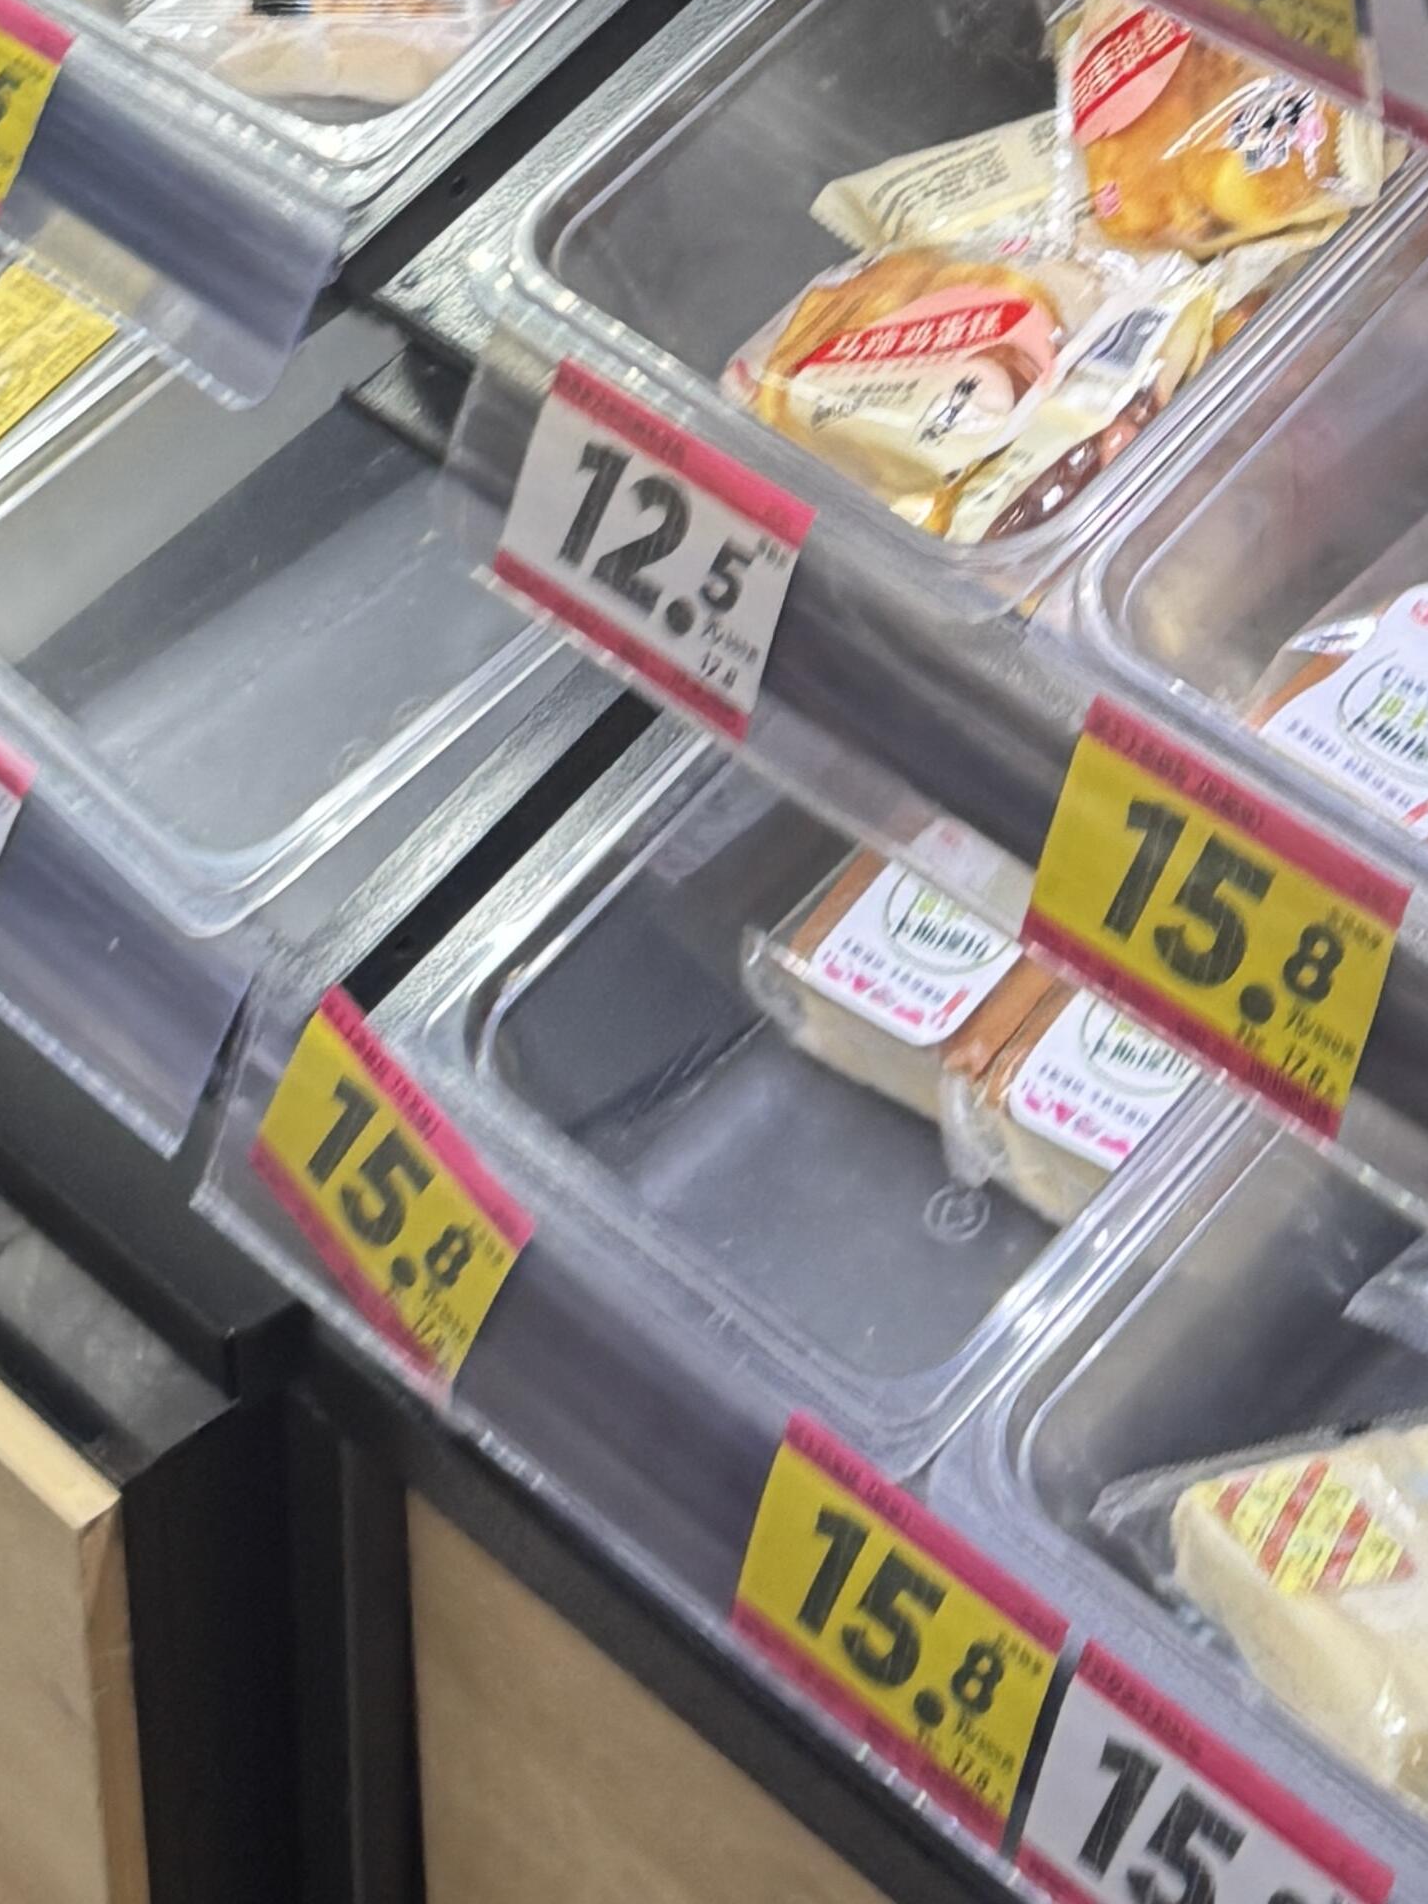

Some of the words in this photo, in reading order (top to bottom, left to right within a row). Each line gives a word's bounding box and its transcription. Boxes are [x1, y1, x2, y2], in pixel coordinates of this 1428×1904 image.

[558, 442, 760, 637] 12.5
[1102, 797, 1345, 1026] 15.8
[305, 1074, 475, 1290] 15.8
[797, 1504, 1005, 1729] 15.8
